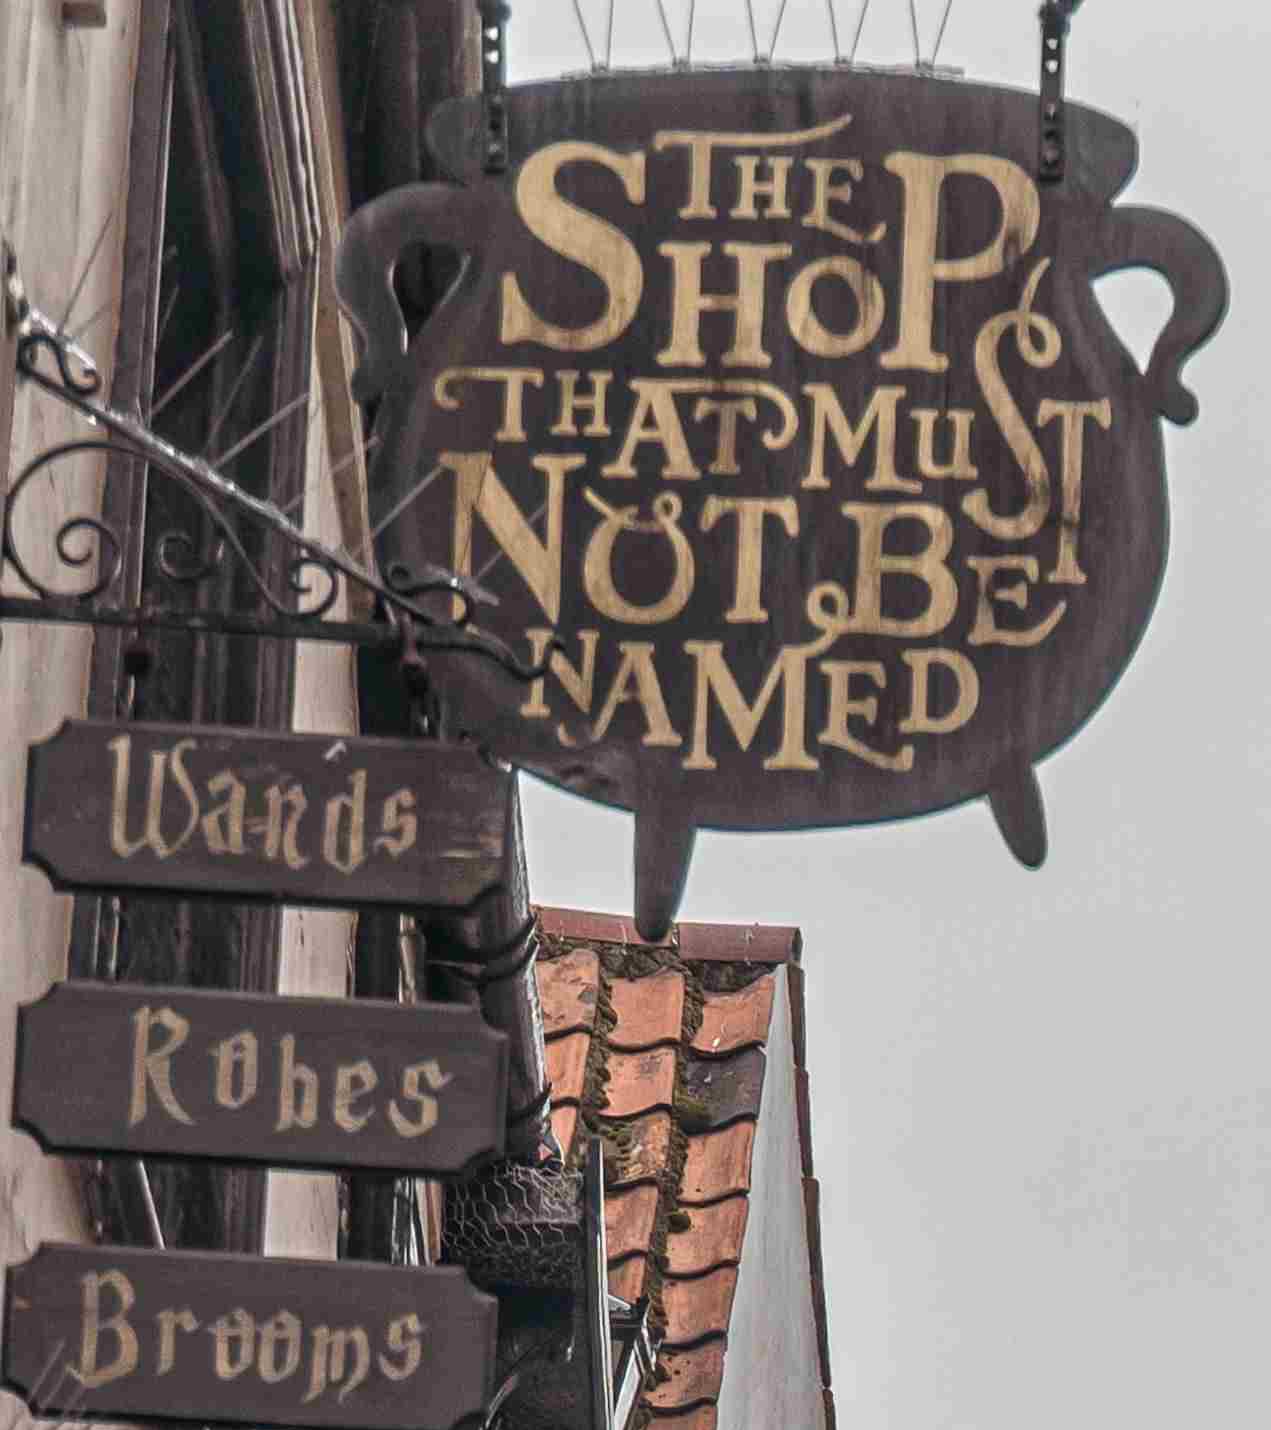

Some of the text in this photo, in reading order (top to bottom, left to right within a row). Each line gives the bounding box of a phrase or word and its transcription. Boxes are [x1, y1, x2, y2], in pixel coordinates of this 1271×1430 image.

[654, 115, 887, 244] THE
[500, 141, 1041, 371] SHOP
[434, 366, 800, 480] THAT
[438, 452, 1067, 647] NOT BE
[520, 628, 981, 773] NAMED
[108, 735, 418, 874] Wands
[130, 1007, 452, 1138] Robes
[66, 1268, 424, 1403] Brooms
